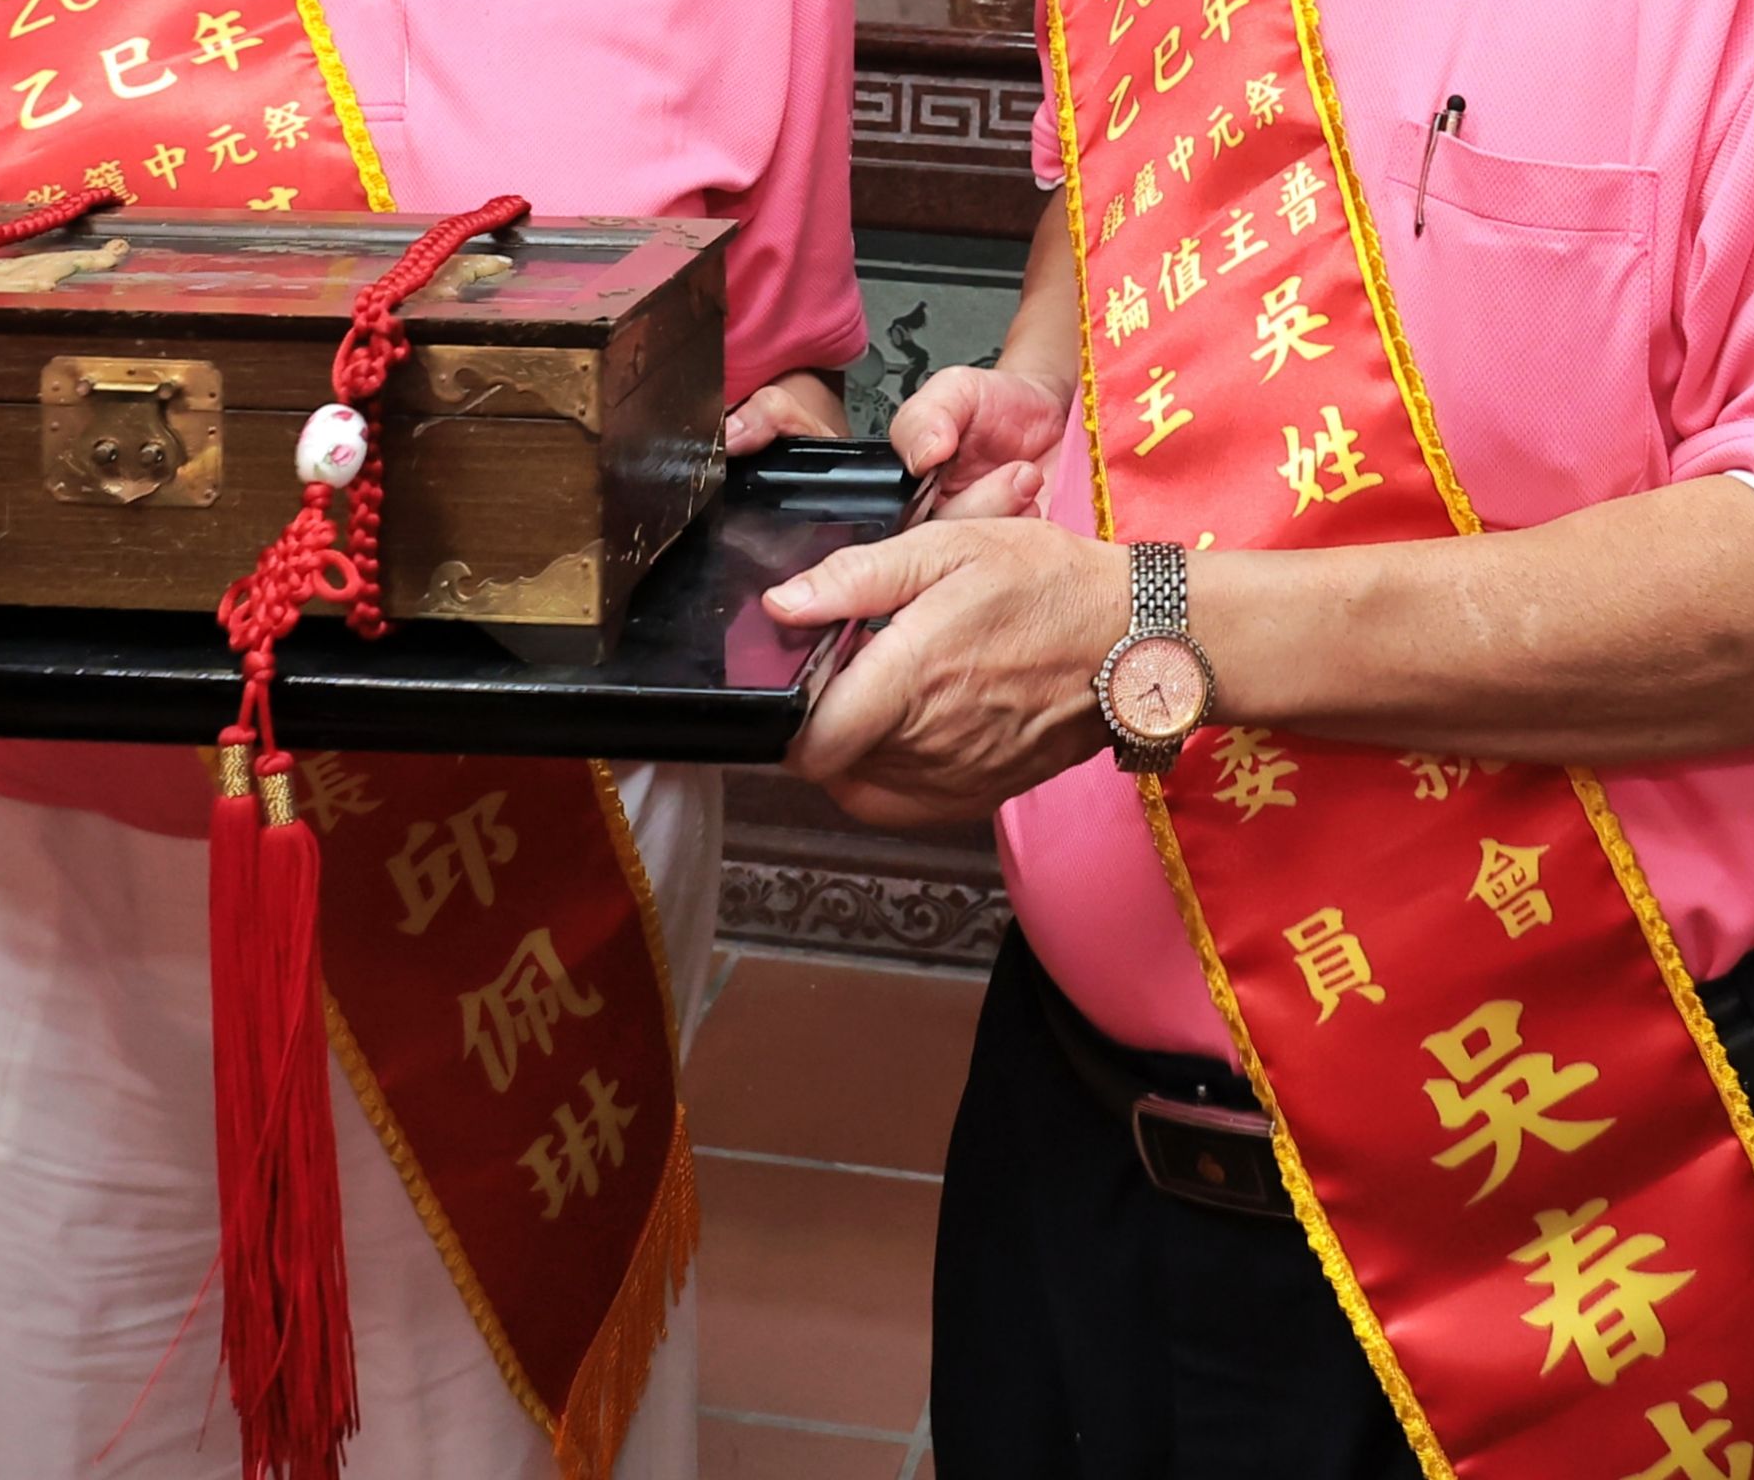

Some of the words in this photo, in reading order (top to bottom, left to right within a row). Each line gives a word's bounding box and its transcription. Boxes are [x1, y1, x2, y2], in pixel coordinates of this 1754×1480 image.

[12, 9, 263, 130] 乙巳年
[1097, 70, 1290, 248] 雞籠中元祭
[1103, 160, 1329, 348] 輪值主普
[1249, 275, 1385, 519] 吳姓
[385, 789, 638, 1221] 邱佩琳
